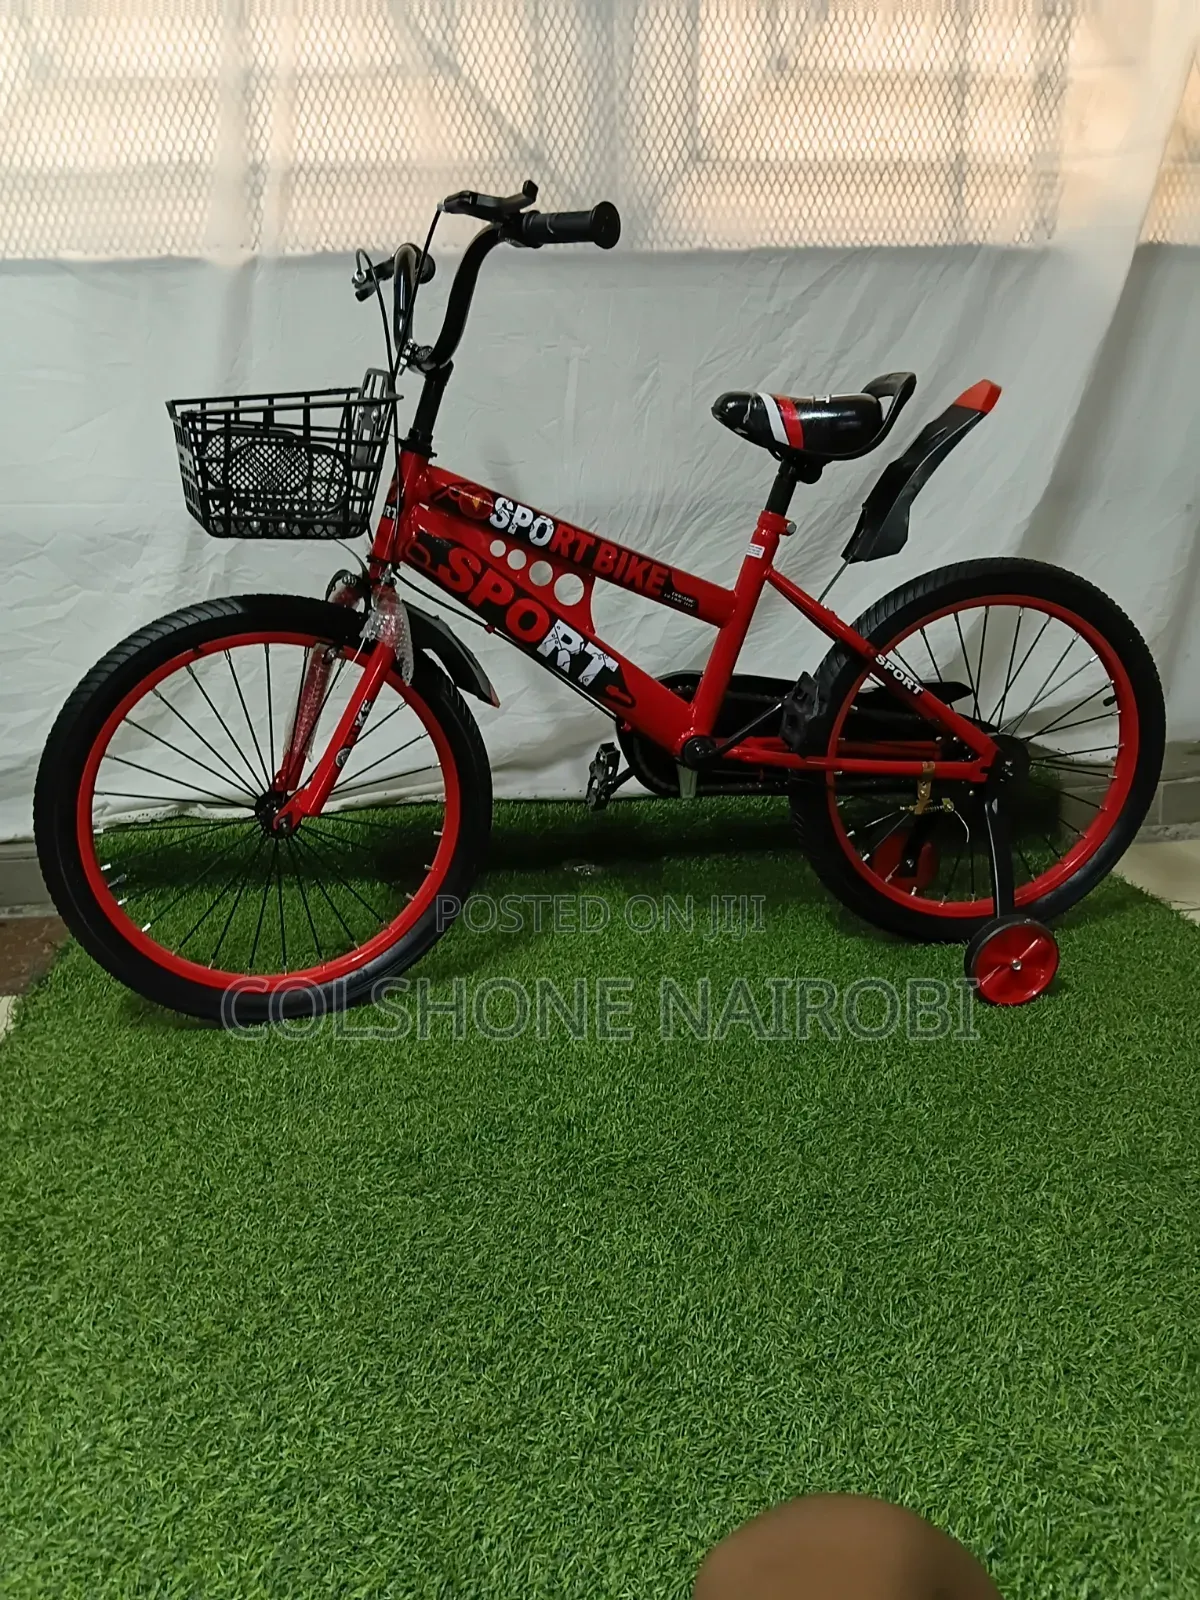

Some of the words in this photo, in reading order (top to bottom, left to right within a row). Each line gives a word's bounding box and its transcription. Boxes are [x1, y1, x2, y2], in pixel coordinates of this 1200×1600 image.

[489, 496, 597, 564] SPORT
[592, 545, 671, 596] BIKE
[437, 547, 619, 687] SPORT
[875, 654, 924, 695] SPORT
